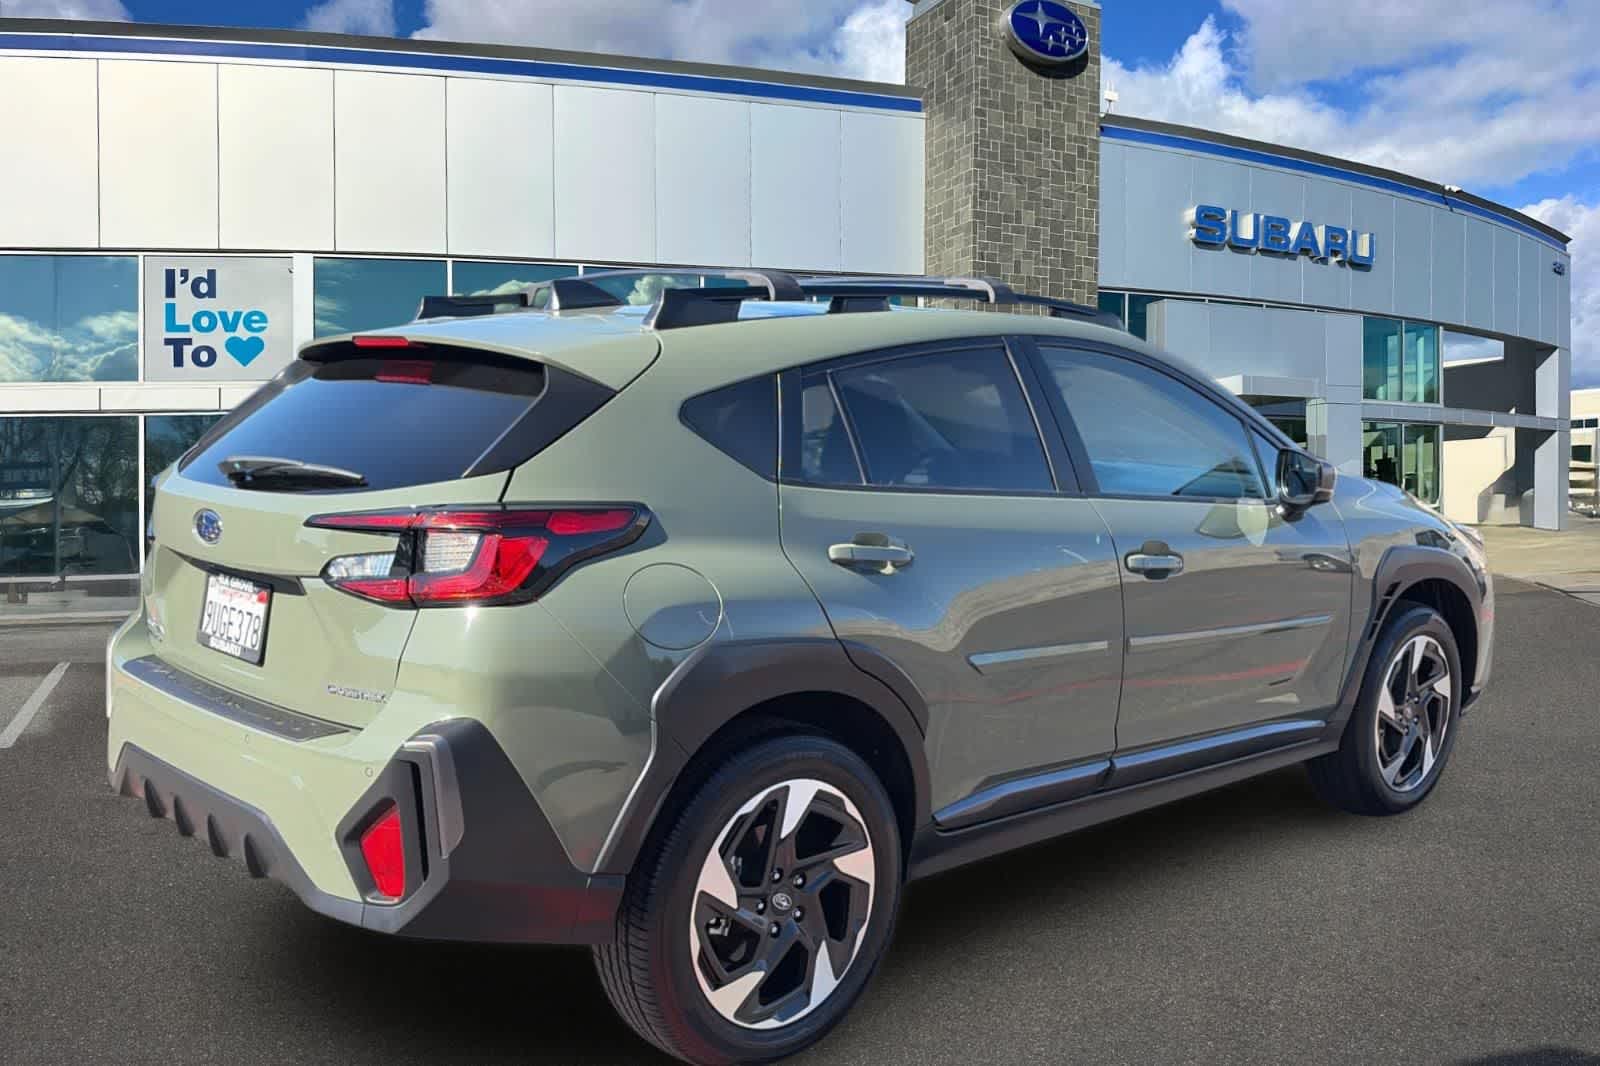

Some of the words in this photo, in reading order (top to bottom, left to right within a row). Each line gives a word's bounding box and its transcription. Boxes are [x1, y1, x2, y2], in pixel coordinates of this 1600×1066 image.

[1193, 204, 1375, 269] SUBARU
[165, 268, 217, 299] I’d
[164, 302, 268, 333] Love
[164, 337, 217, 368] To
[204, 600, 262, 649] 9UGE378
